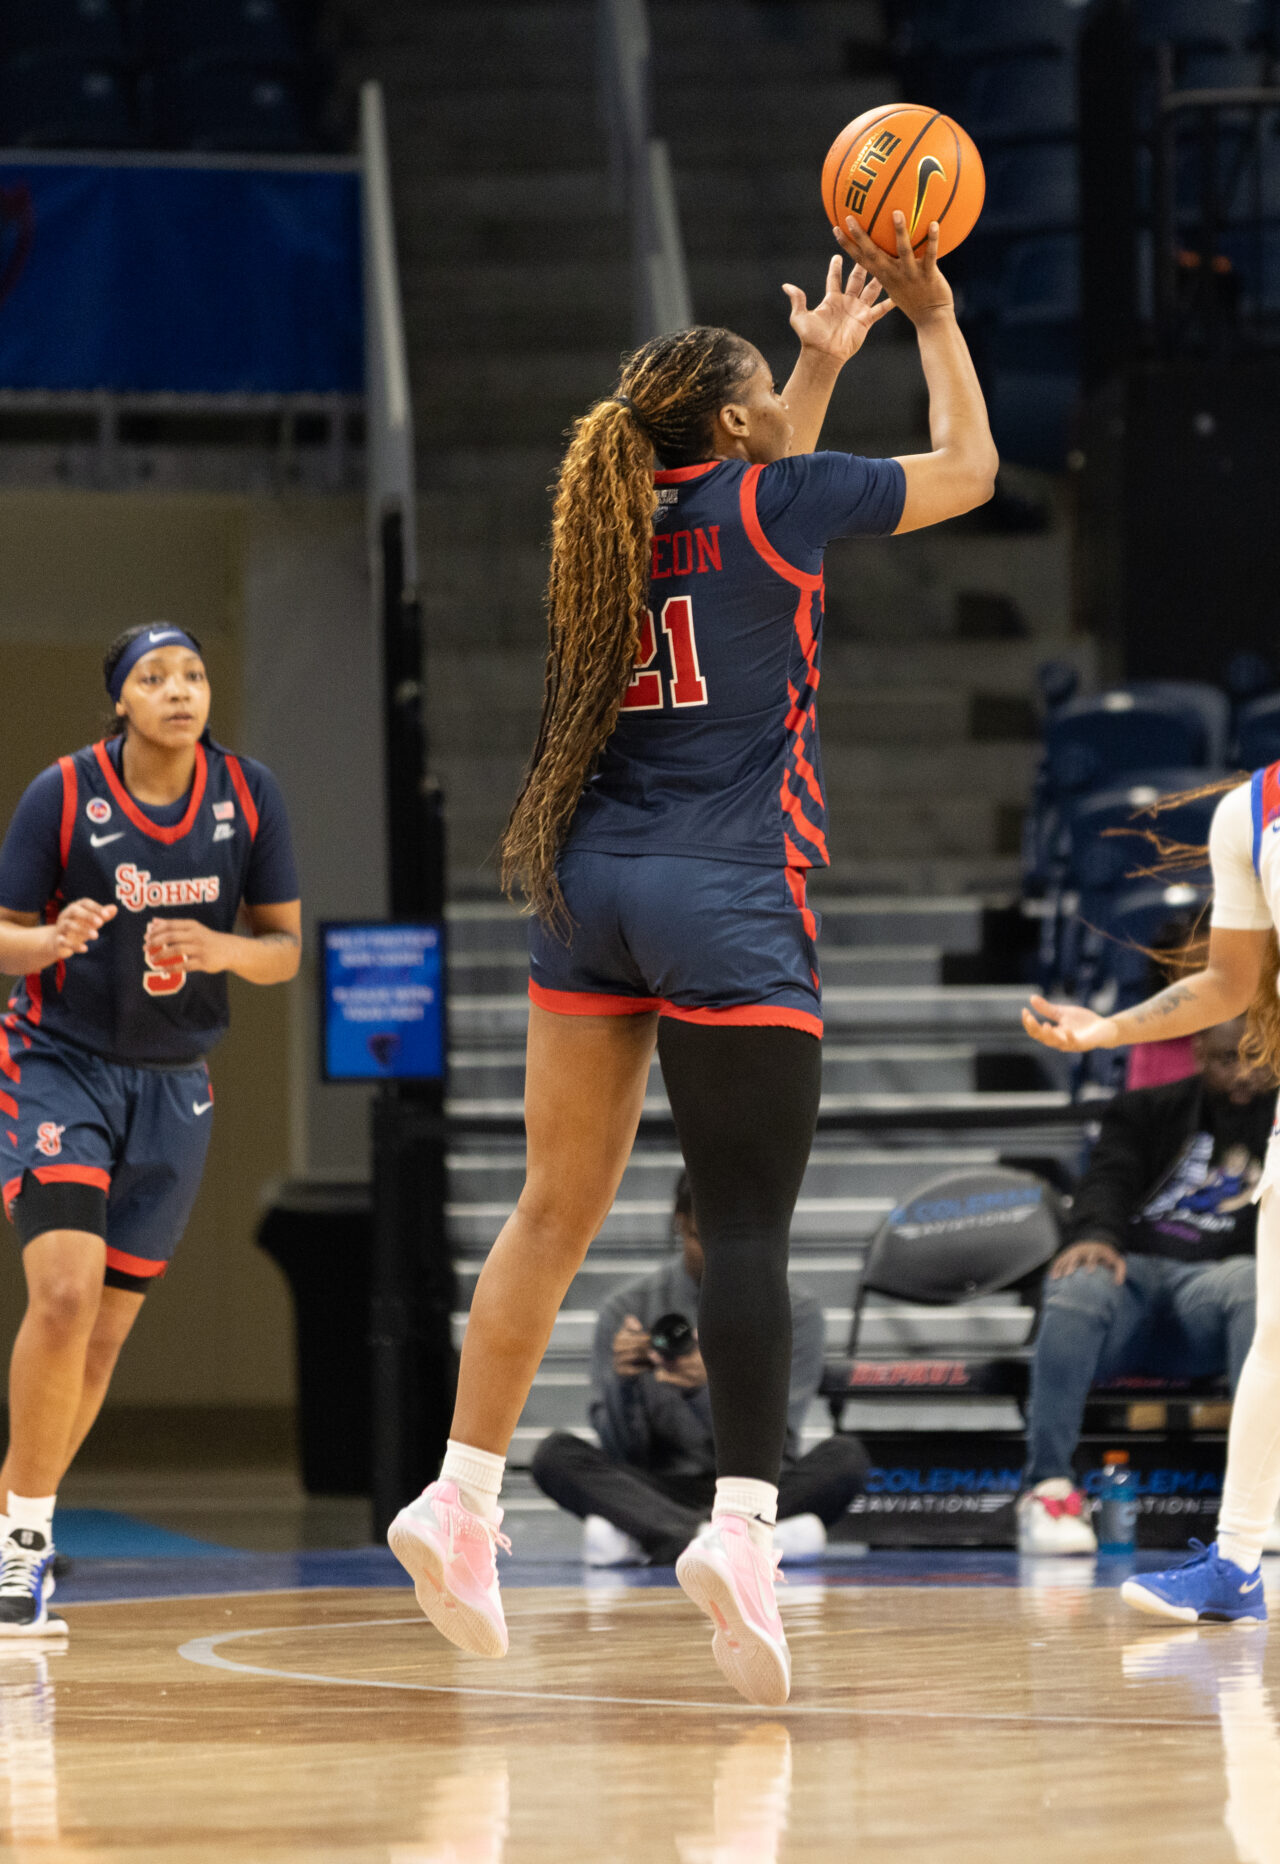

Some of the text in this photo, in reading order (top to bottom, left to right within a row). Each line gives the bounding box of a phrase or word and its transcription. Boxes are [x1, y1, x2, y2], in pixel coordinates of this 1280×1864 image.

[844, 130, 902, 215] ELITE
[650, 525, 723, 580] EON
[618, 595, 709, 713] 21
[865, 1467, 1021, 1493] COLEMAN
